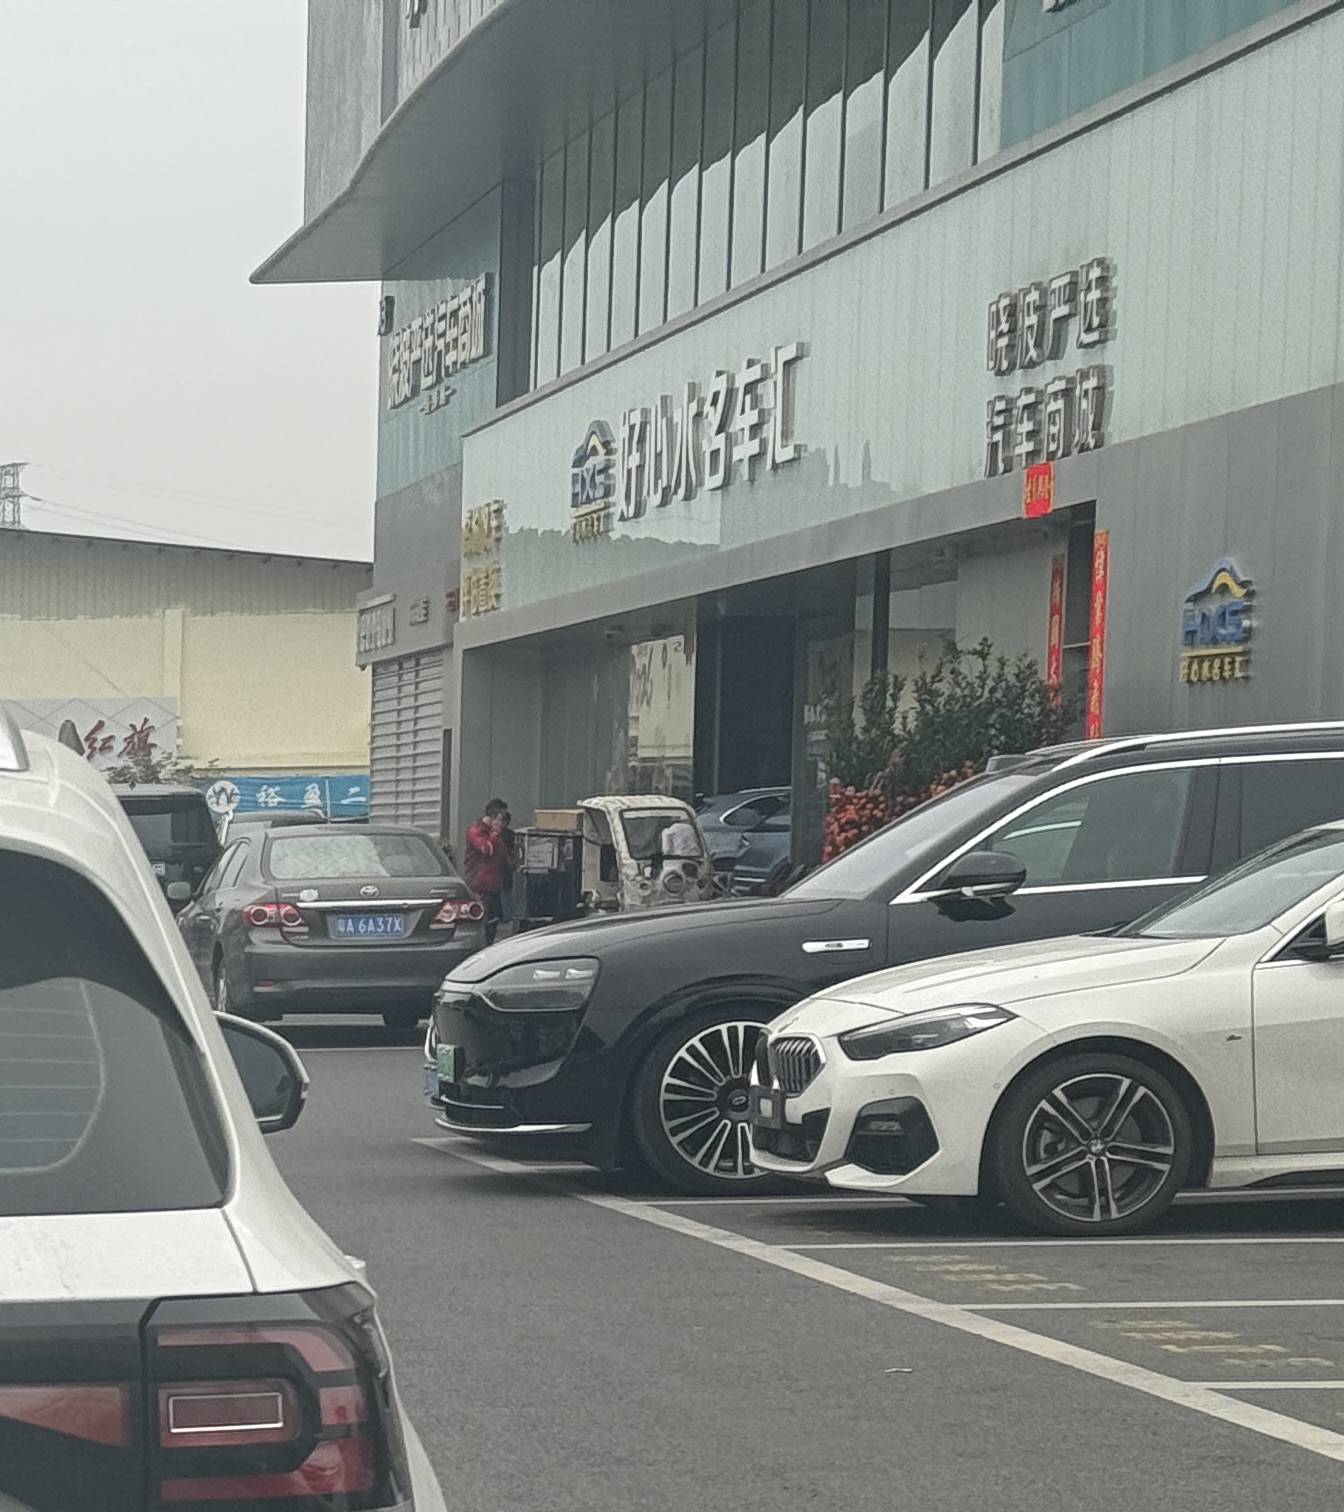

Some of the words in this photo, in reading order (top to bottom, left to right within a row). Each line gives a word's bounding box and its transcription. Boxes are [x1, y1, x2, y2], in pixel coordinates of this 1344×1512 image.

[986, 257, 1109, 376] 晓波严选
[617, 341, 804, 522] 好心水名车汇
[986, 365, 1107, 477] 汽车商城
[83, 717, 158, 760] 红旗
